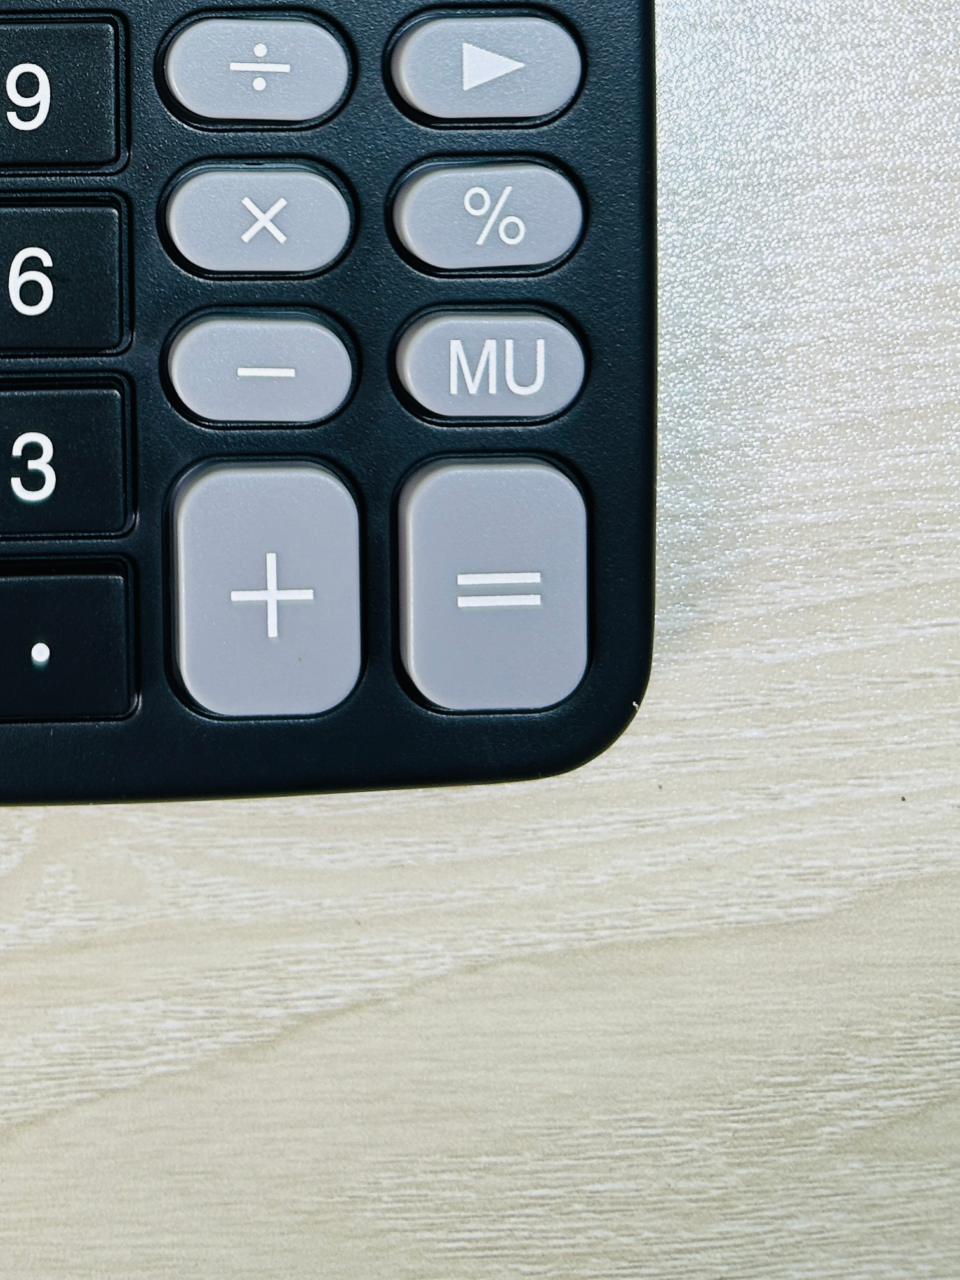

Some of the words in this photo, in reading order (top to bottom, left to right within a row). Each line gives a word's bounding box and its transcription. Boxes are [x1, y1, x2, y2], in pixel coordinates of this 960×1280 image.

[5, 62, 52, 131] 9
[463, 185, 527, 247] %
[8, 246, 55, 316] 6
[448, 338, 546, 397] MU
[10, 431, 57, 502] 3
